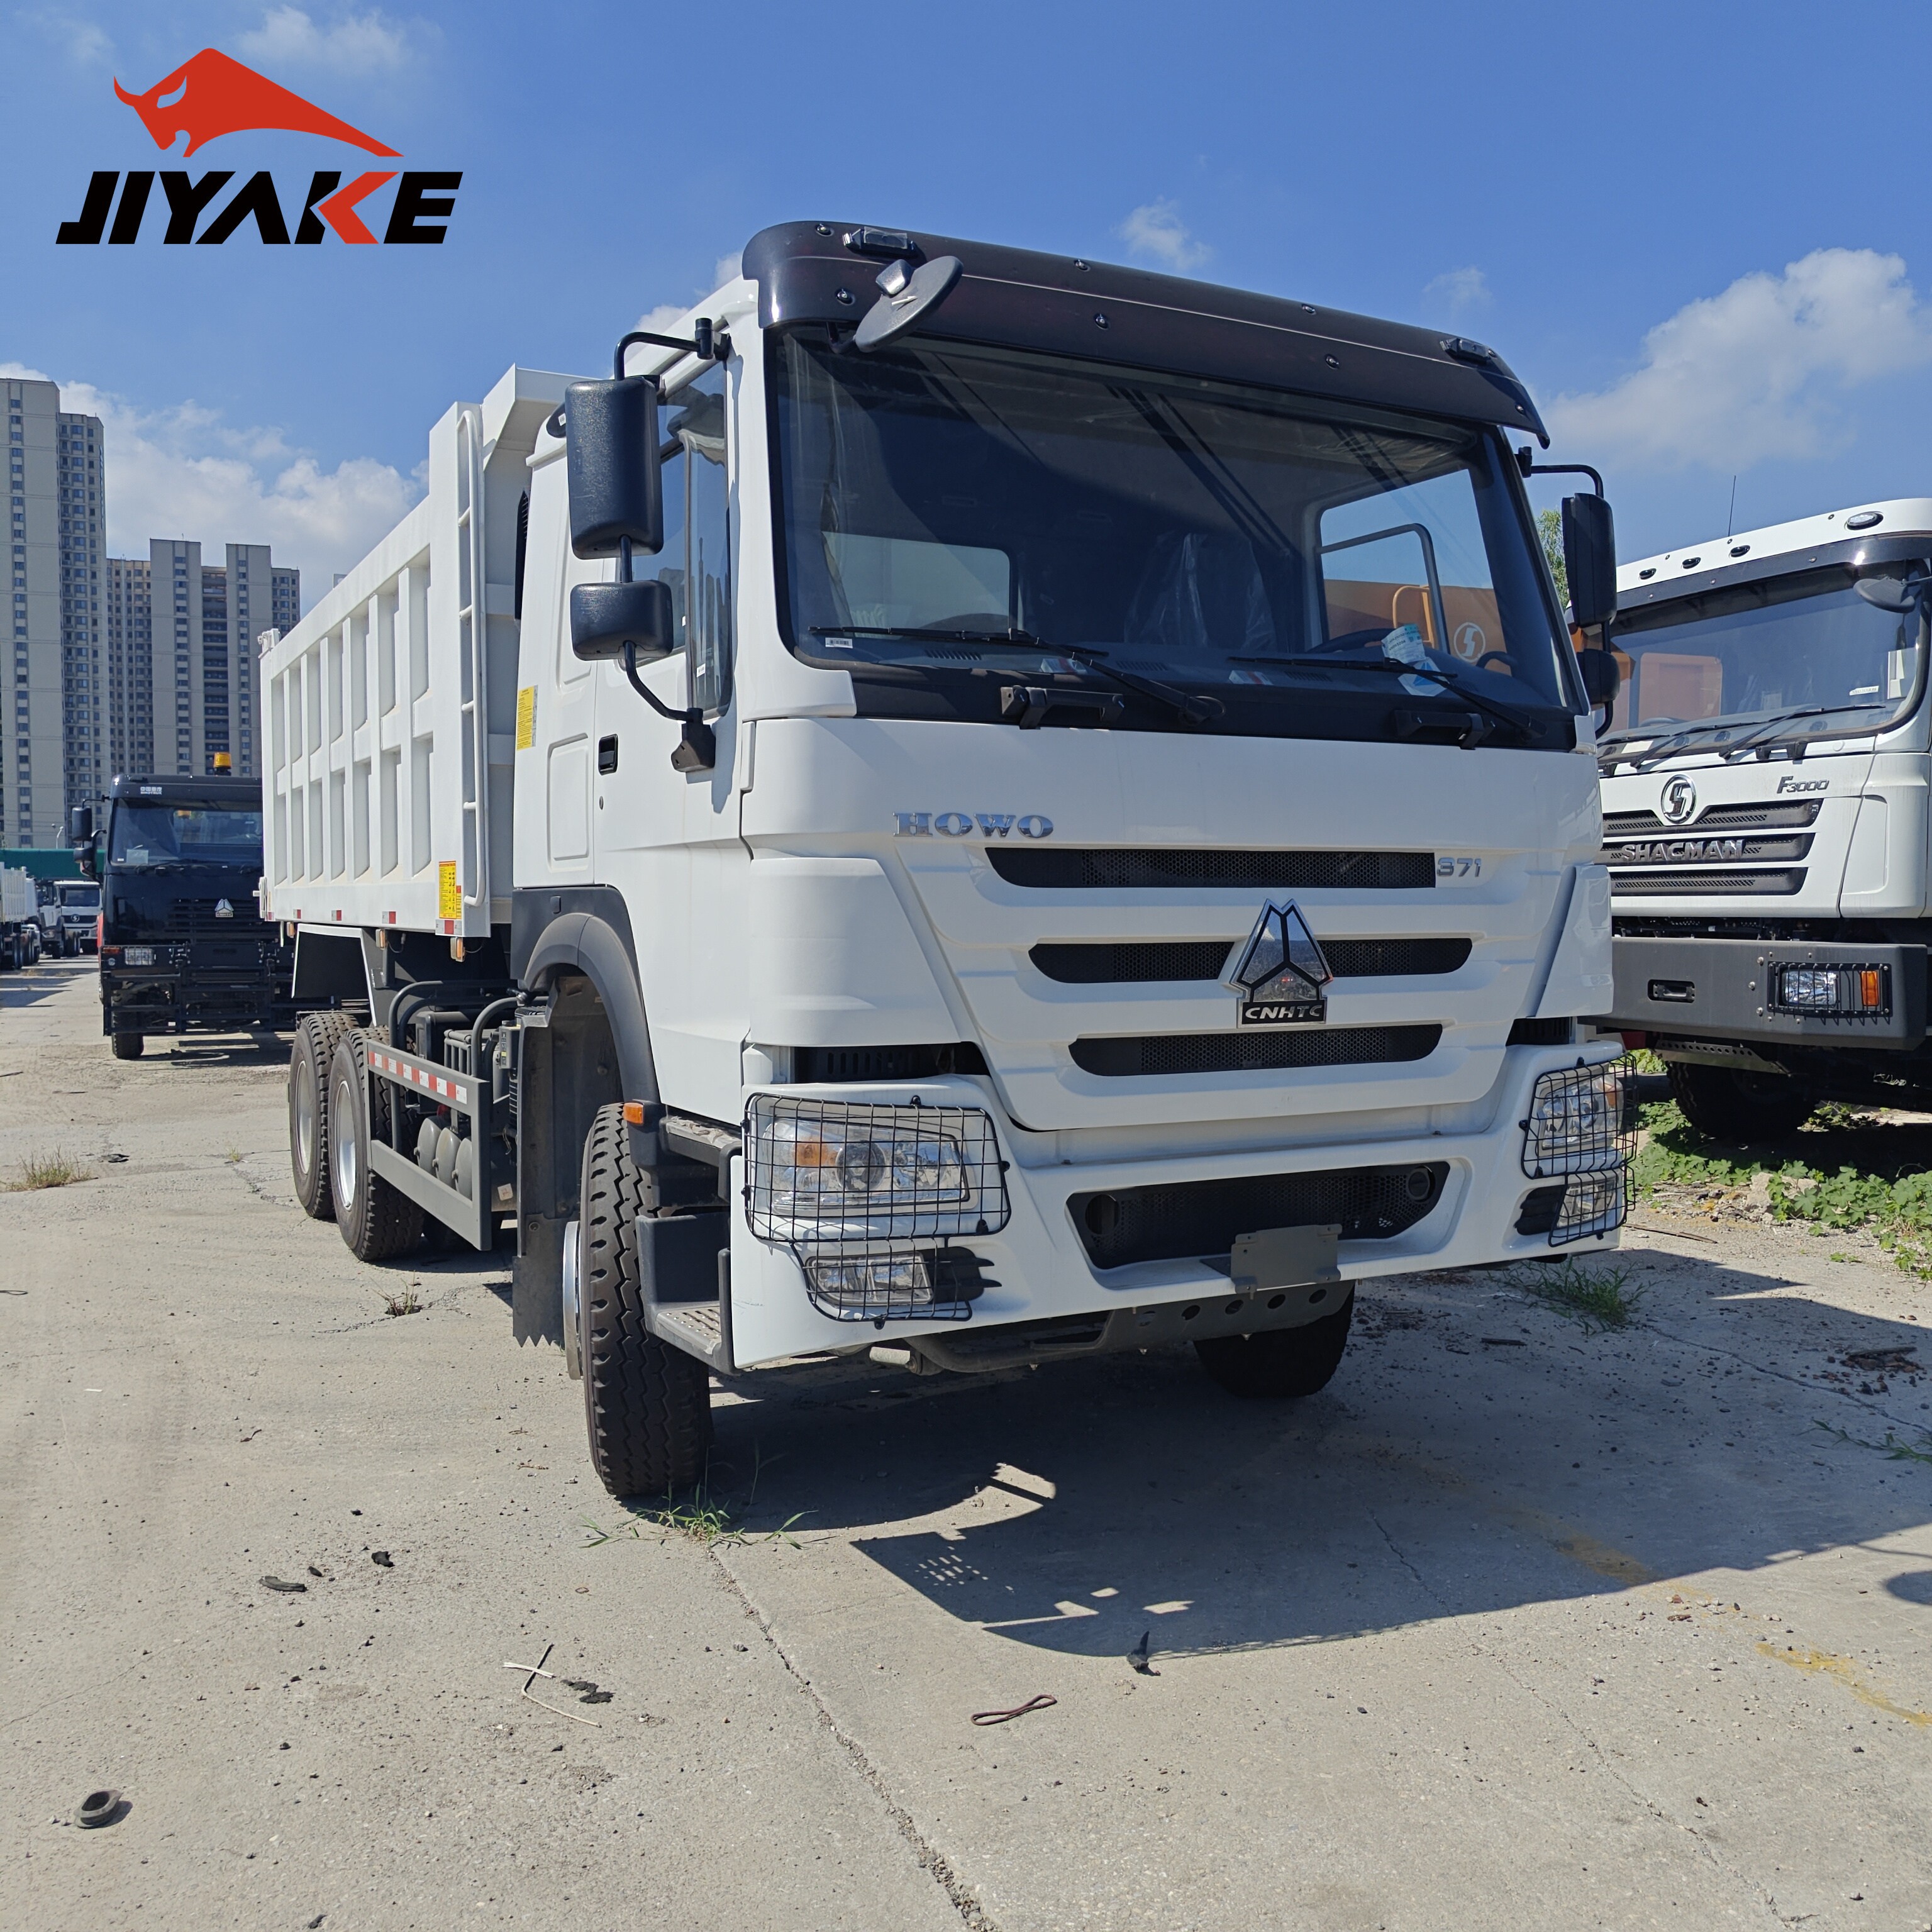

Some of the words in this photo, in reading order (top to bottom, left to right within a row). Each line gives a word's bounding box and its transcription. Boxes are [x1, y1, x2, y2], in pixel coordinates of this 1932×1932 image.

[1777, 775, 1829, 794] F3000
[892, 812, 1054, 838] HOWO
[1621, 839, 1745, 862] SHACMAN
[1436, 857, 1482, 877] 371
[1245, 1005, 1323, 1019] CNHTC
